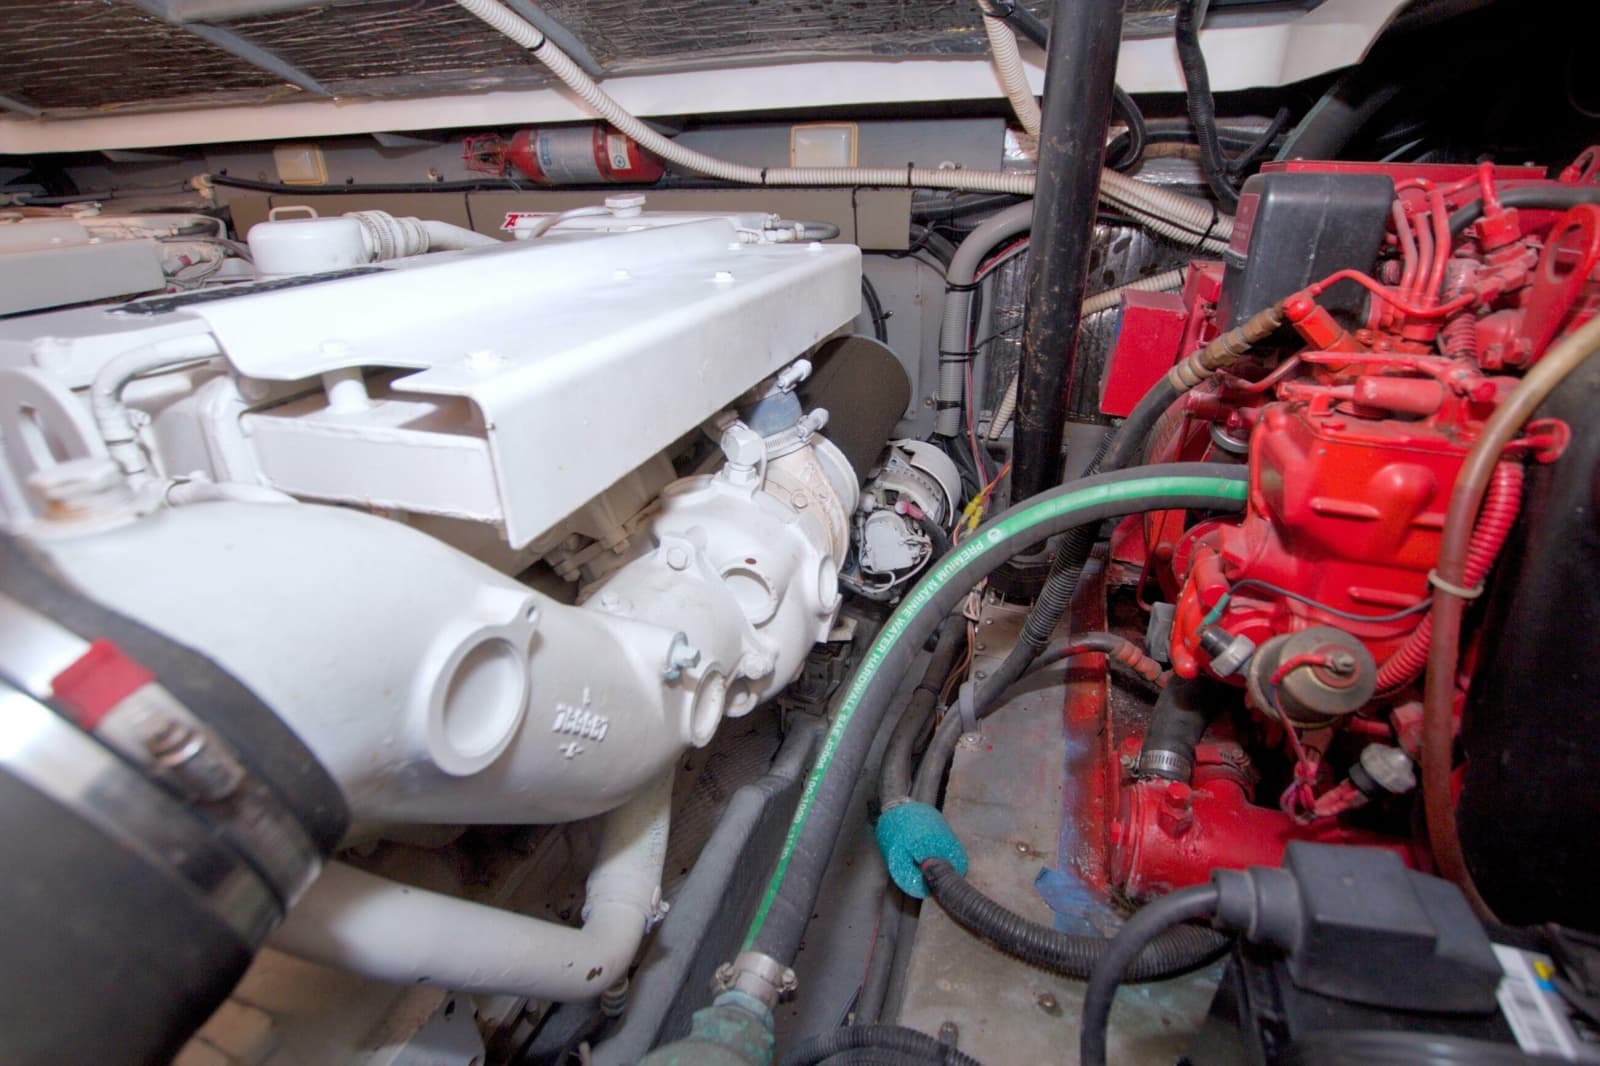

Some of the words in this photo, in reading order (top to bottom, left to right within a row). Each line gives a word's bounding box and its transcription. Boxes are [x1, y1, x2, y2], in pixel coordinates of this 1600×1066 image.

[935, 541, 985, 581] PREMIUM
[902, 578, 938, 617] MARINE
[876, 617, 906, 653] WATER
[841, 652, 881, 711] HARDWALL
[831, 713, 847, 736] SAE
